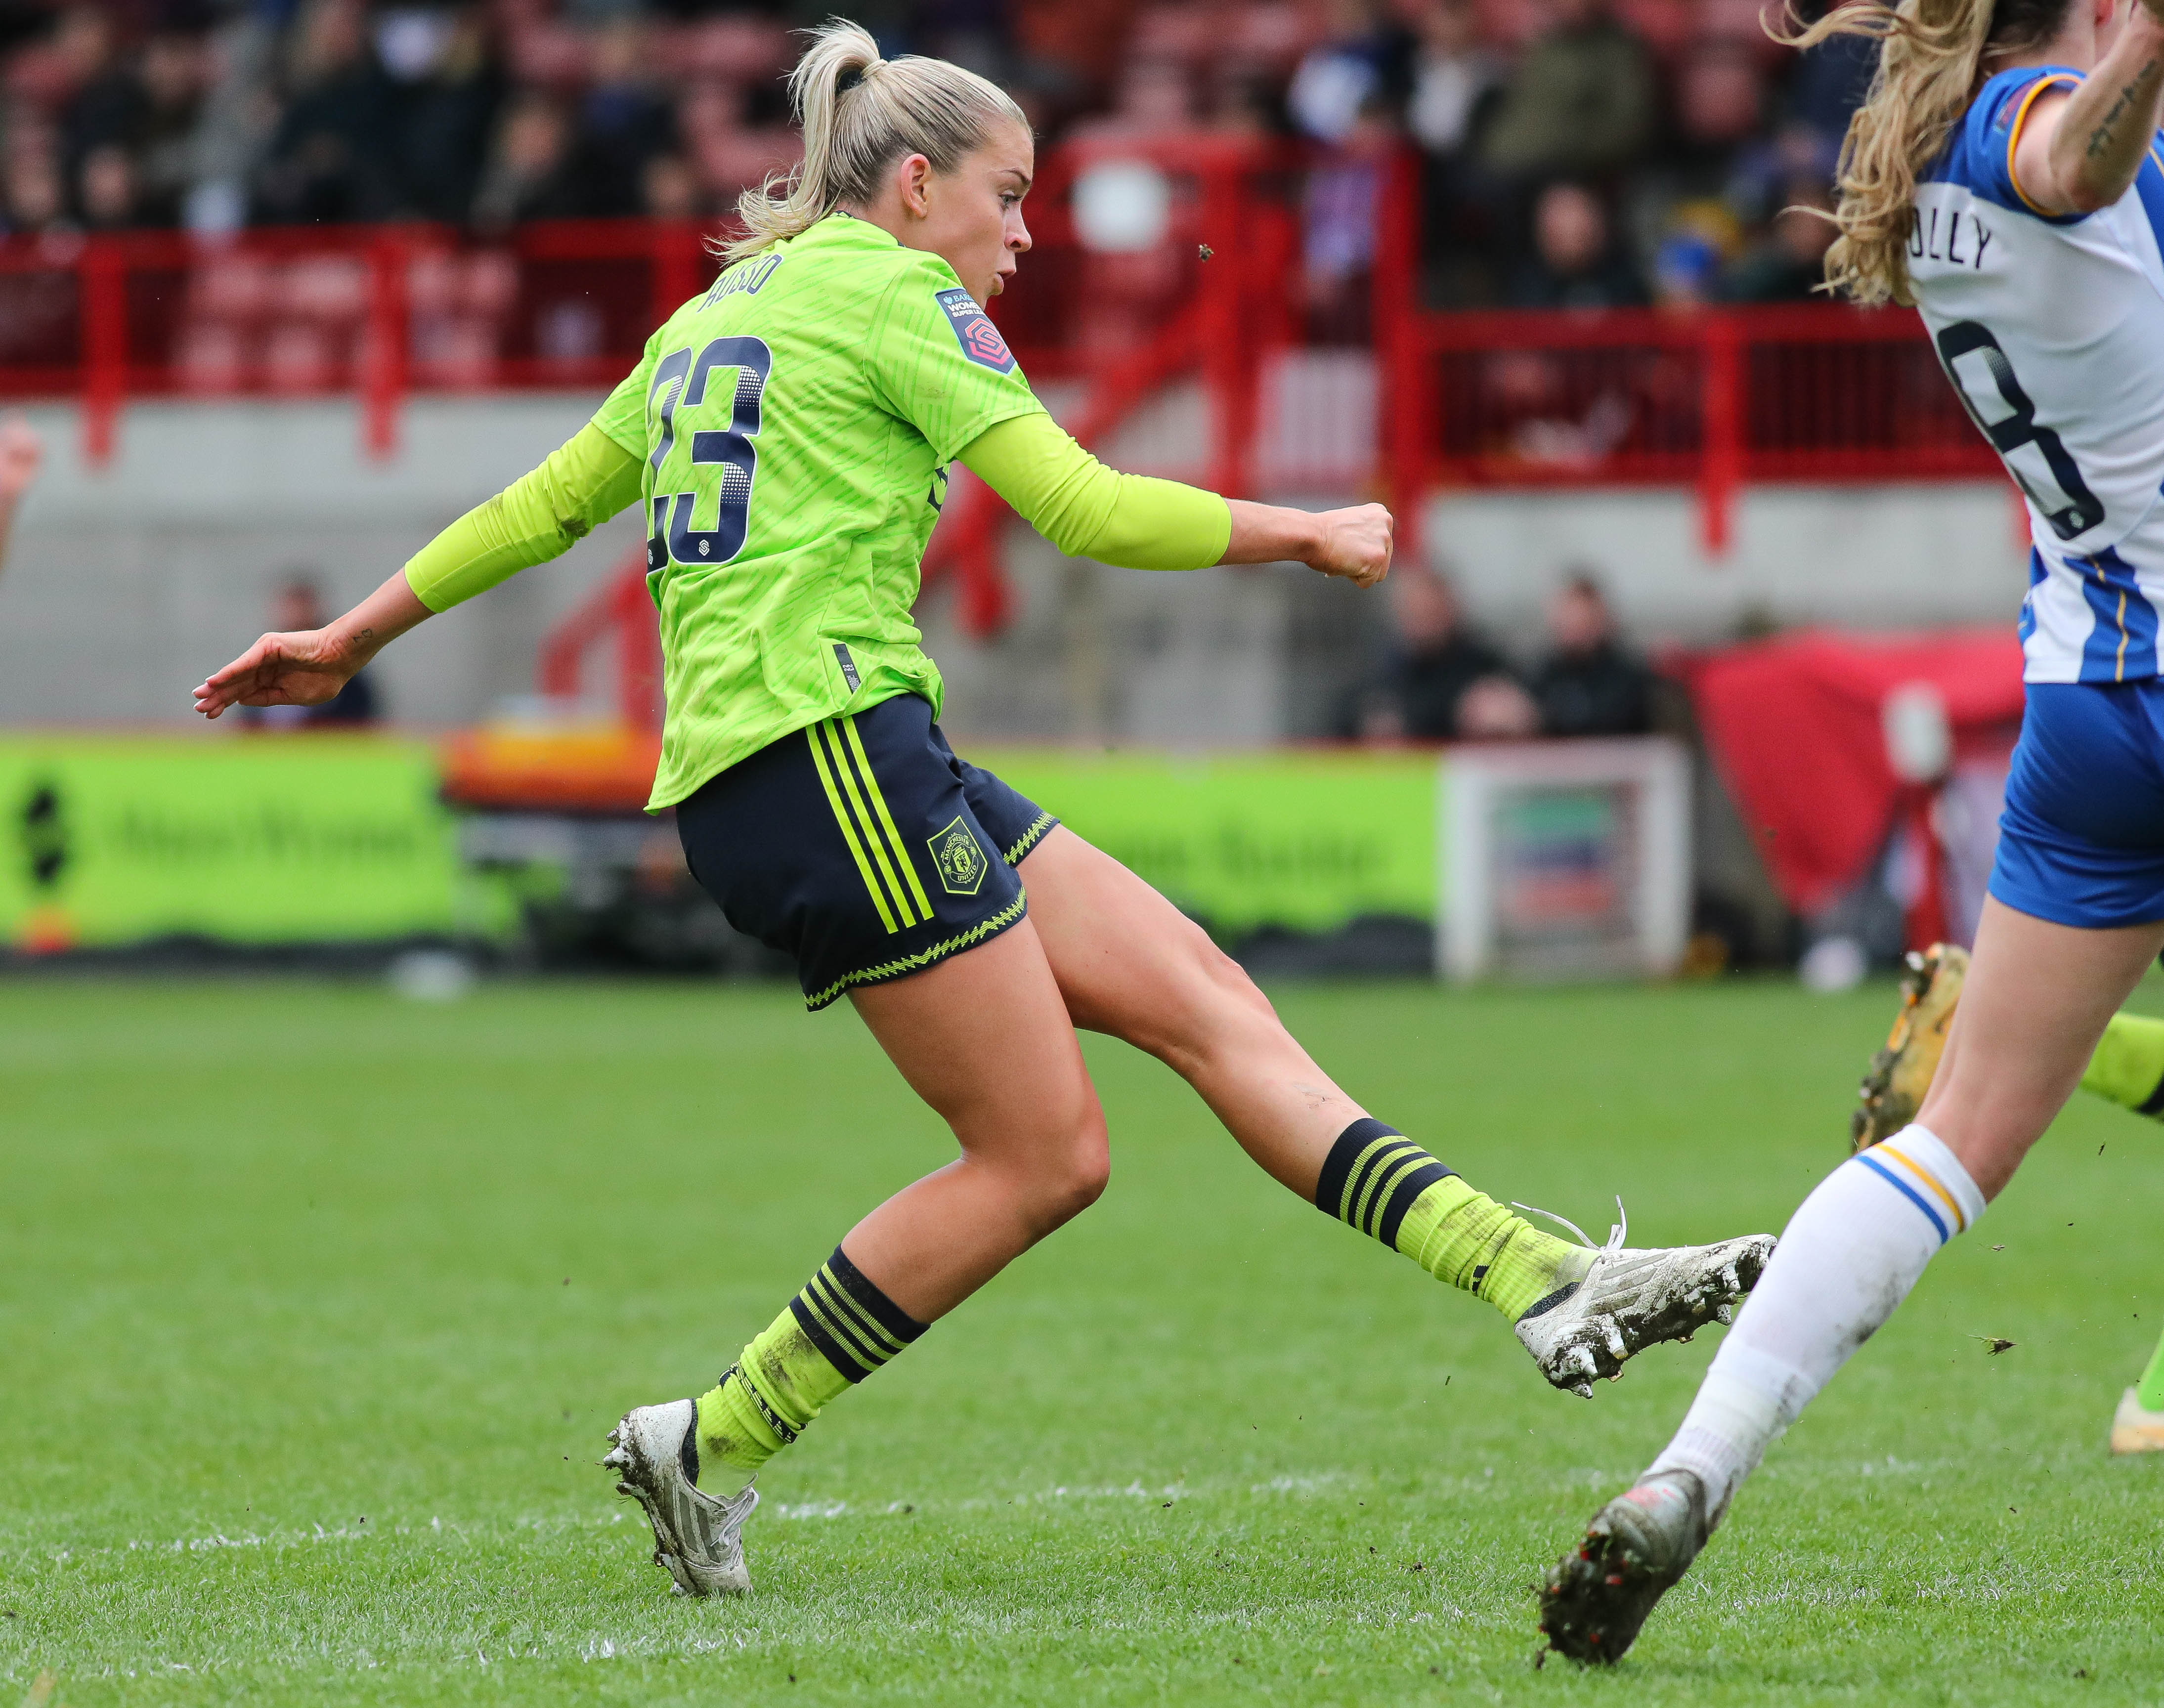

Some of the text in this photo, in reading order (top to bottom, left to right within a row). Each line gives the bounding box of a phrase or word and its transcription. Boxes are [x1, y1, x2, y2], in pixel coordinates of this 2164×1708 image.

[696, 254, 783, 313] RUSSO
[647, 335, 773, 576] 23
[1937, 320, 2105, 541] 8
[944, 836, 969, 860] MANCHESTER
[958, 865, 977, 881] UNITED
